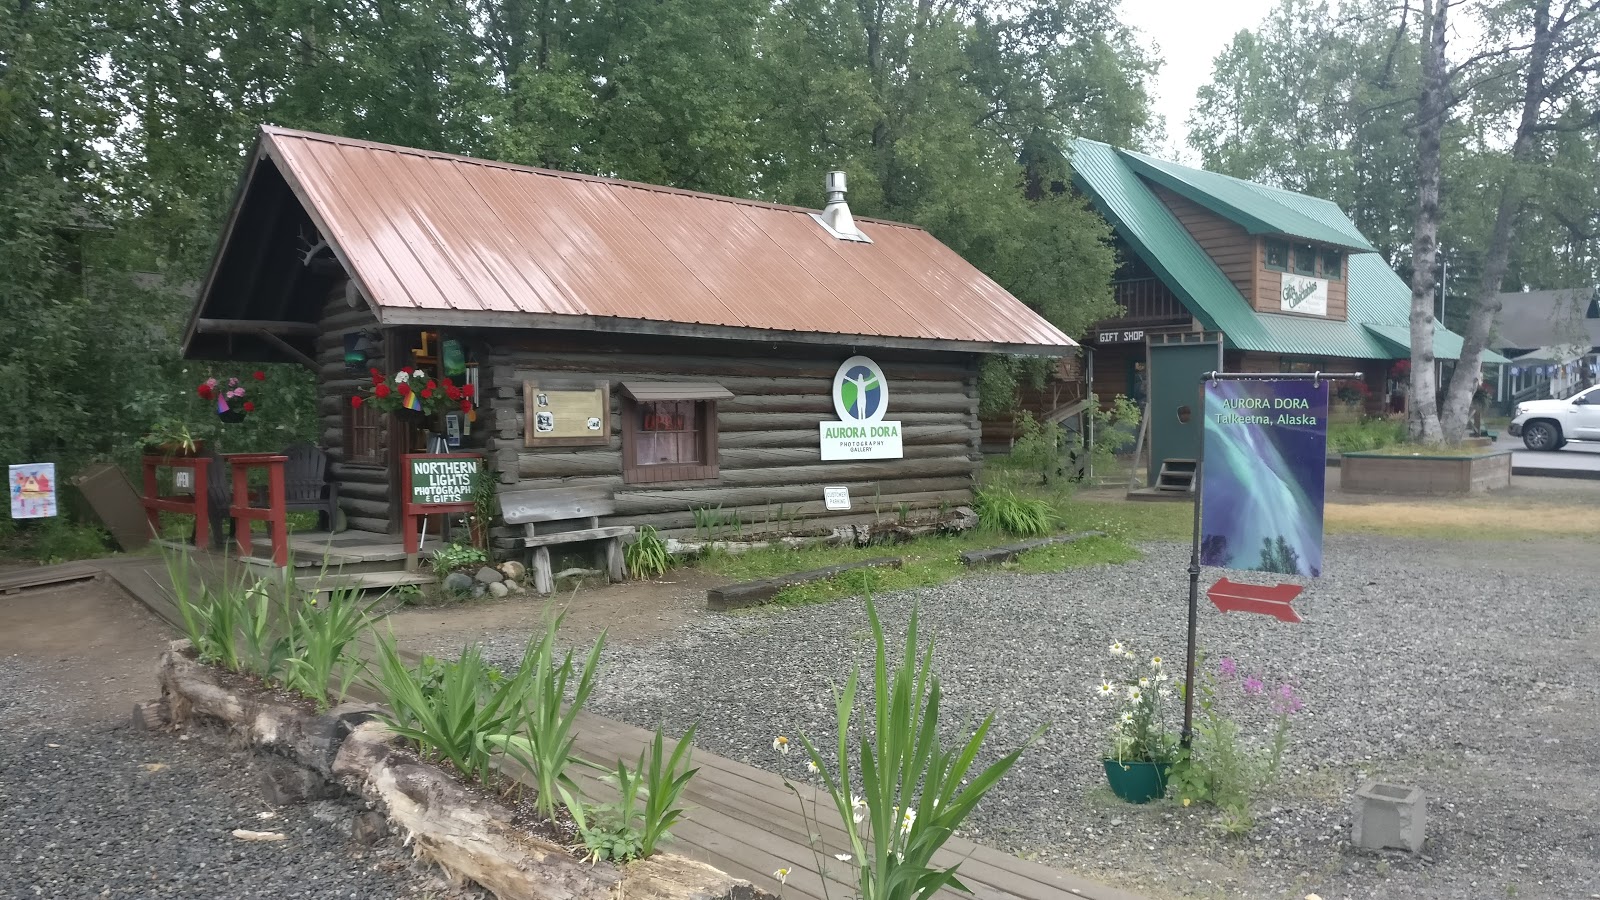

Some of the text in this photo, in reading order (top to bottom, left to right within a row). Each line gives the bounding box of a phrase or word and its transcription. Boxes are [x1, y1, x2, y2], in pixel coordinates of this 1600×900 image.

[1099, 331, 1144, 343] GIFT SHOP
[1223, 398, 1309, 409] AURORA DORA
[1215, 413, 1317, 426] Talkeetna, Alaska
[825, 426, 898, 439] AURORA DORA
[414, 462, 477, 475] NORTHERN
[176, 471, 189, 488] OPEN
[429, 474, 470, 486] LIGHTS
[414, 485, 474, 496] PHOTOGRAPH
[433, 494, 462, 503] GIFTS
